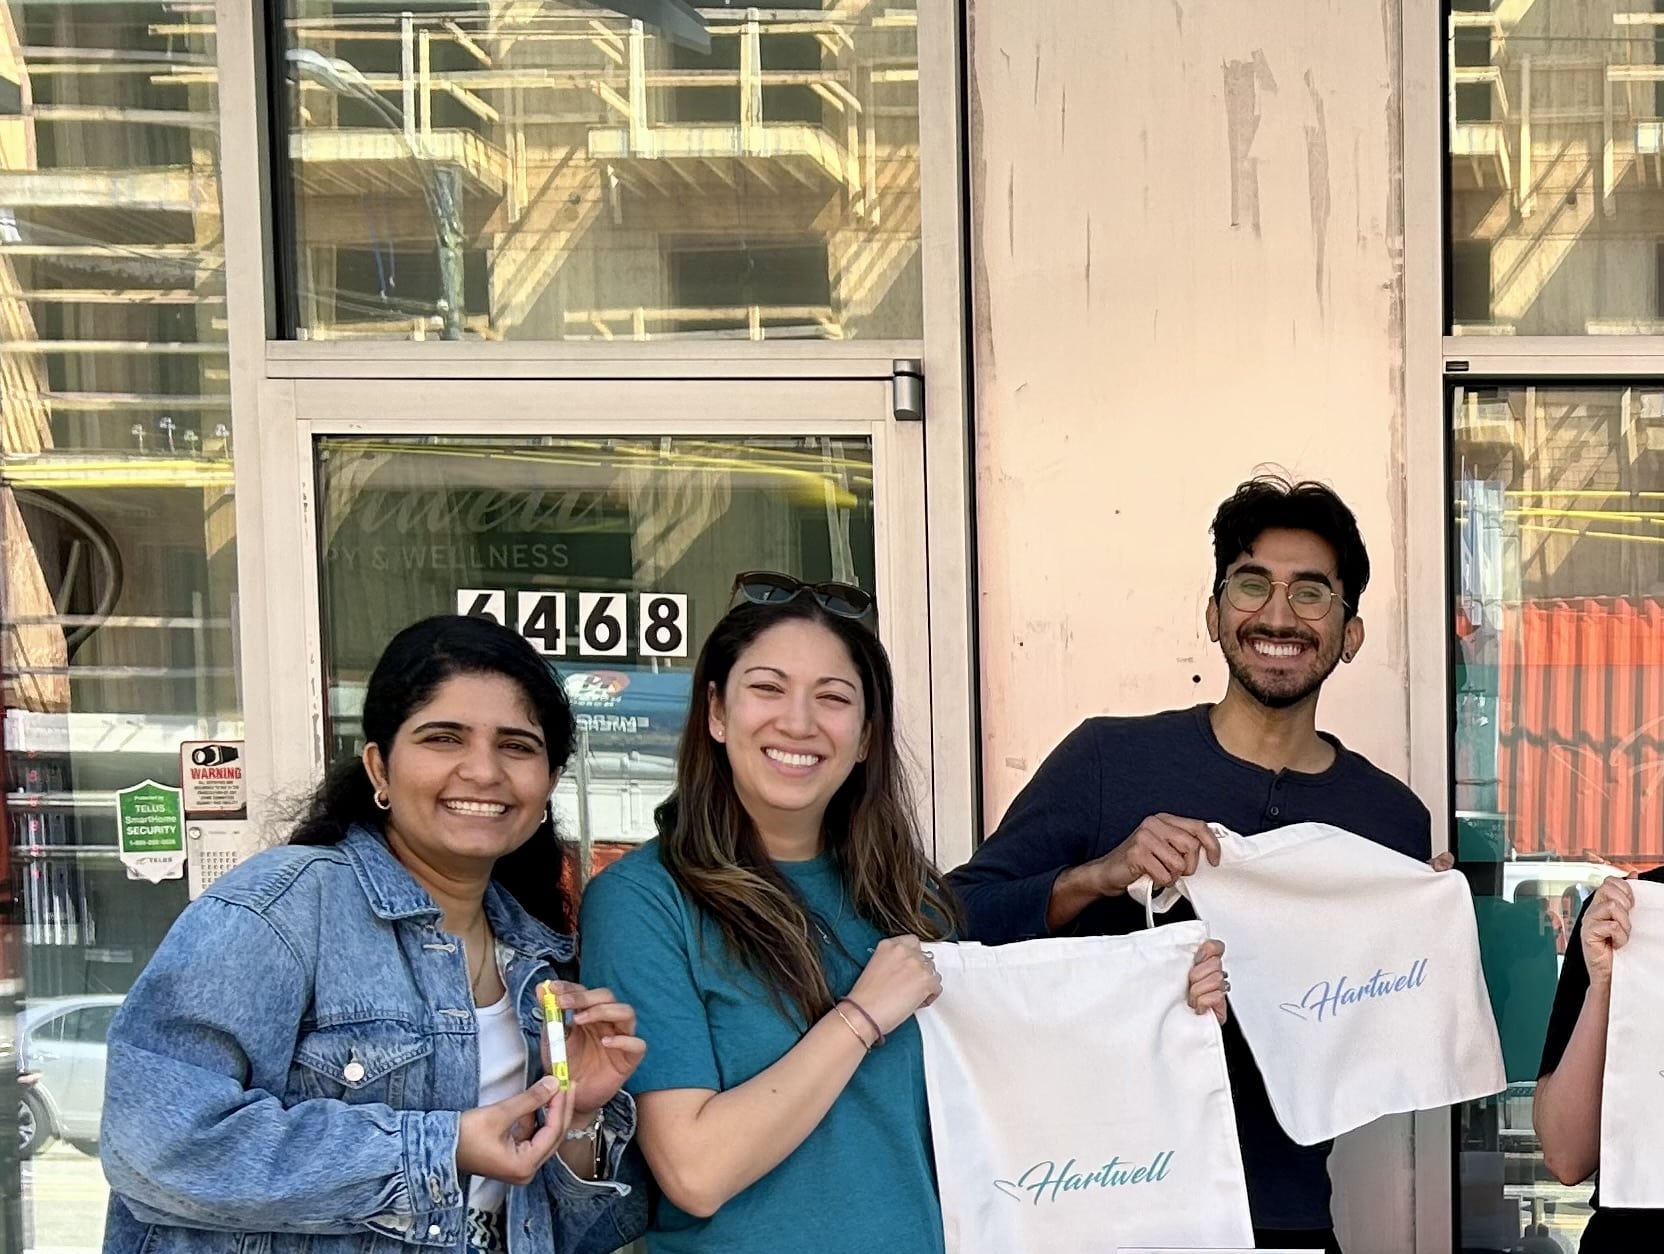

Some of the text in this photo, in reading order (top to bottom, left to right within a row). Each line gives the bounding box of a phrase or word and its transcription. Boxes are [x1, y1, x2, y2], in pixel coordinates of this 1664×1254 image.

[402, 543, 570, 569] WELLNESS
[466, 593, 683, 653] 6468
[190, 768, 242, 780] WARNING
[135, 804, 166, 813] TELUS
[125, 815, 177, 825] SmartHome
[126, 825, 177, 836] SECURITY
[1304, 957, 1429, 1022] Hartwell
[1018, 1150, 1175, 1206] Hartwell
